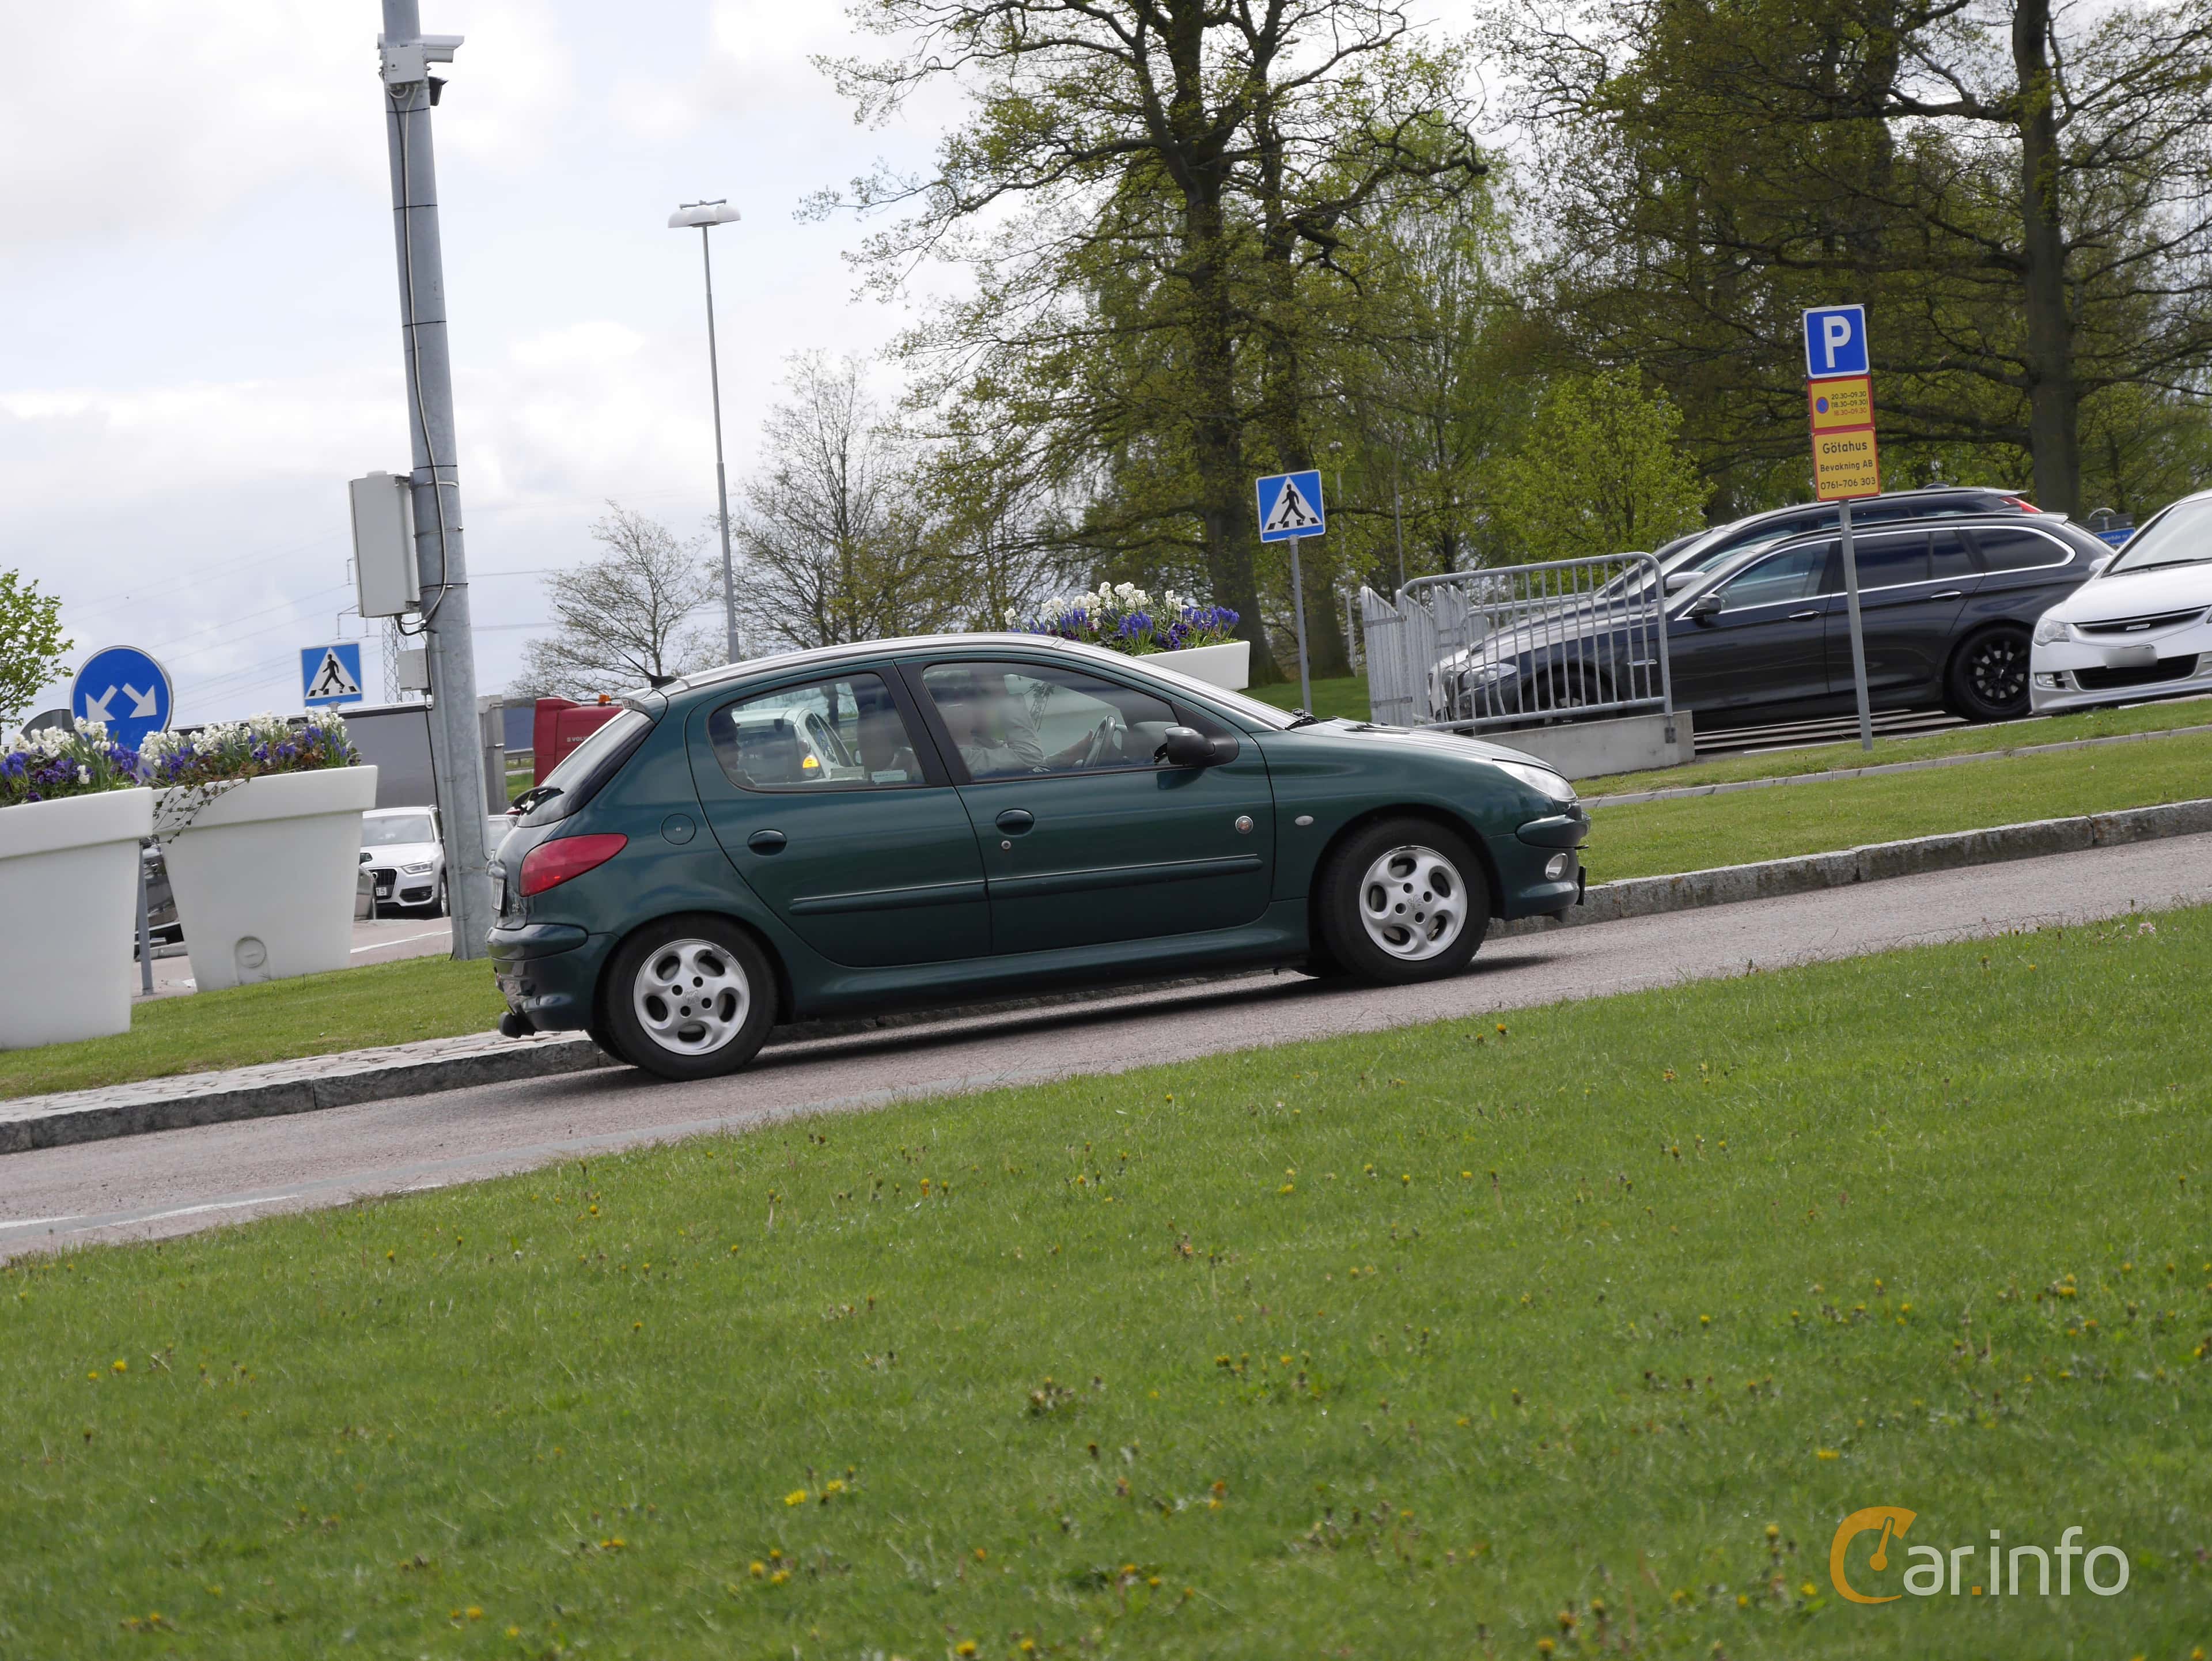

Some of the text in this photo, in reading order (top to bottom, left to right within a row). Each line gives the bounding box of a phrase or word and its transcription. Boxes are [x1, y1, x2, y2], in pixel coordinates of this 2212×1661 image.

[1823, 315, 1851, 368] P
[1823, 441, 1868, 453] Götahus
[1820, 459, 1873, 472] Bevakning AB
[1820, 476, 1876, 490] 0761-706 303
